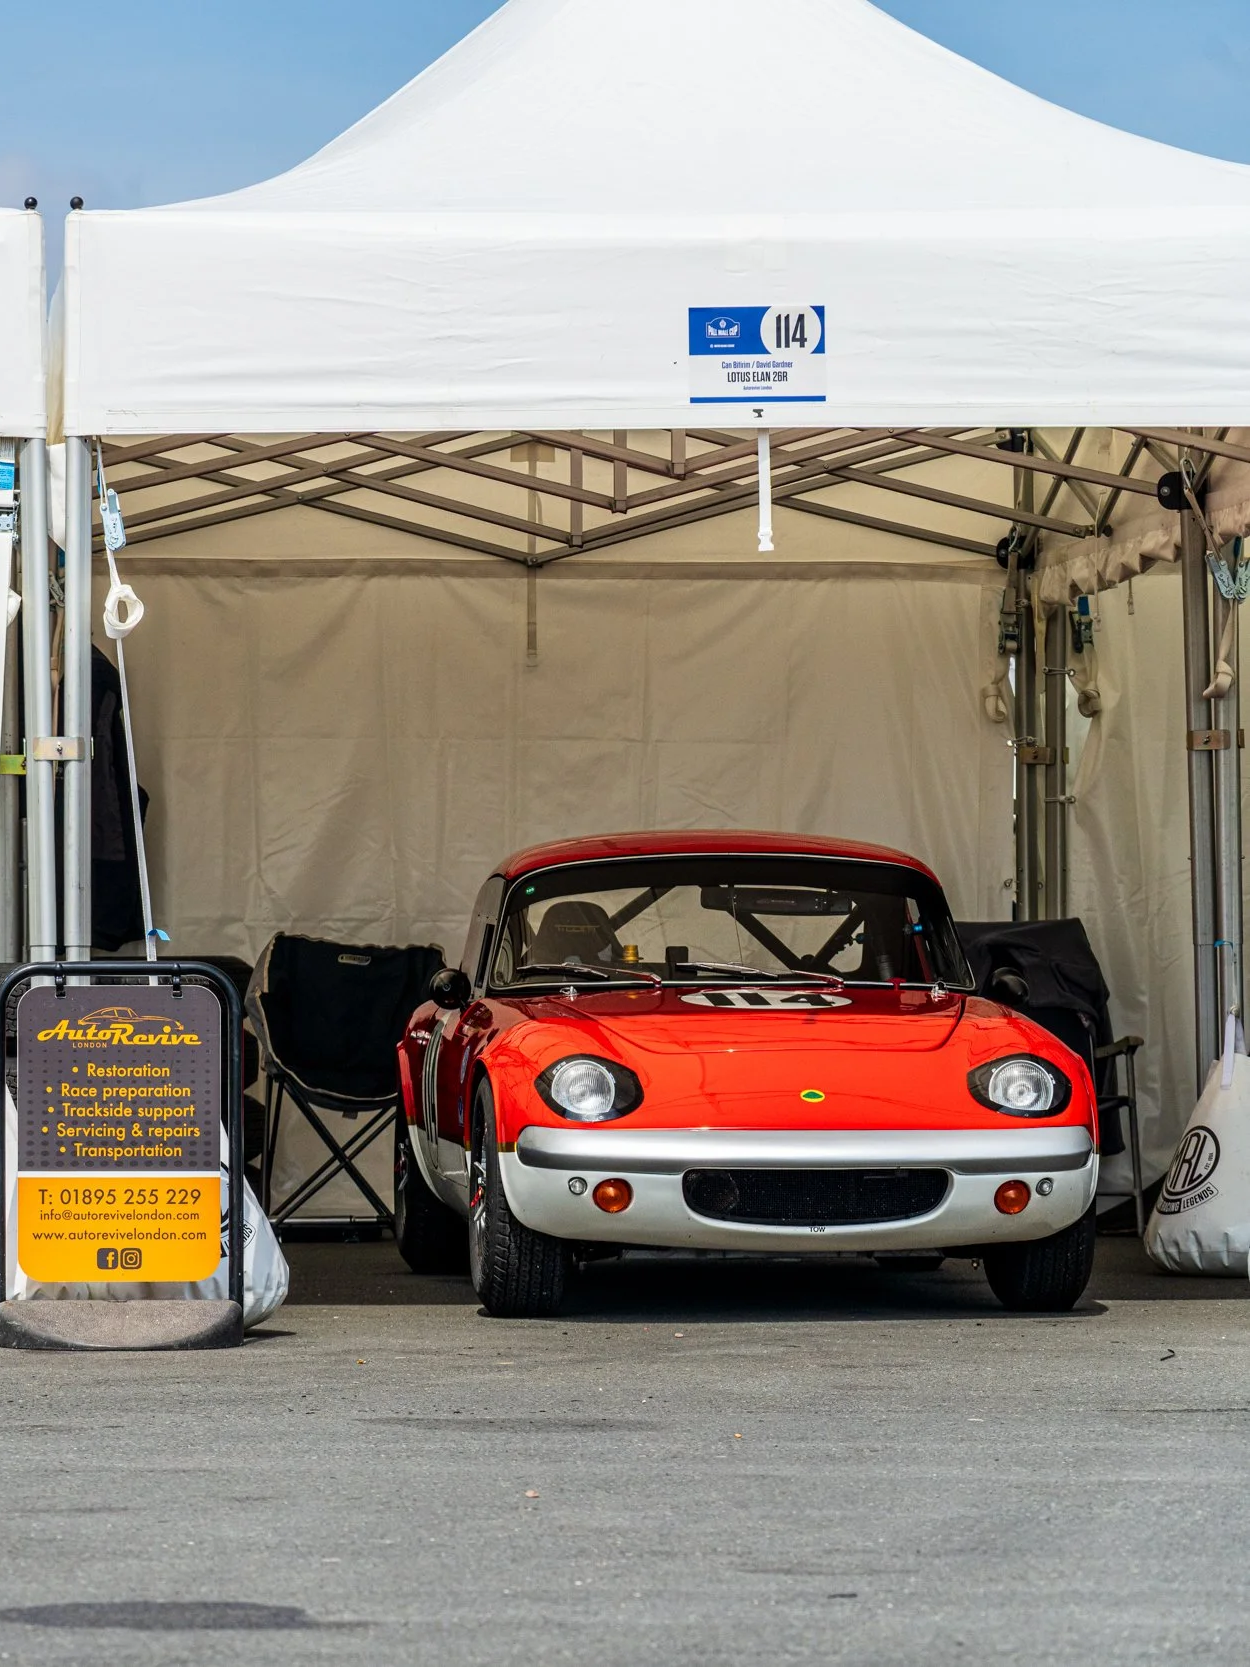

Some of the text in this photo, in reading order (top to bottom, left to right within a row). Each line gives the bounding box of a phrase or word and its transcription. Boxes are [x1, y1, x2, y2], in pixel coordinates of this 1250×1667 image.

[775, 313, 808, 349] 114
[721, 361, 732, 369] Can
[756, 361, 771, 369] David
[772, 360, 794, 369] Gardner
[727, 371, 788, 383] LOTUS ELAN 26R
[701, 992, 836, 1007] 114
[37, 1018, 202, 1046] AutoRevive
[87, 1063, 171, 1078] Restoration
[61, 1083, 191, 1101] Race preparation
[62, 1102, 195, 1121] Trackside support
[56, 1123, 201, 1141] Servicing & repairs
[74, 1143, 183, 1161] Transportation
[38, 1188, 202, 1206] T: 01895 255 229
[1182, 1186, 1214, 1209] LEGENDS
[40, 1209, 200, 1221] info@autorevivelondon.com
[32, 1228, 207, 1241] www.autorevivelondon.com
